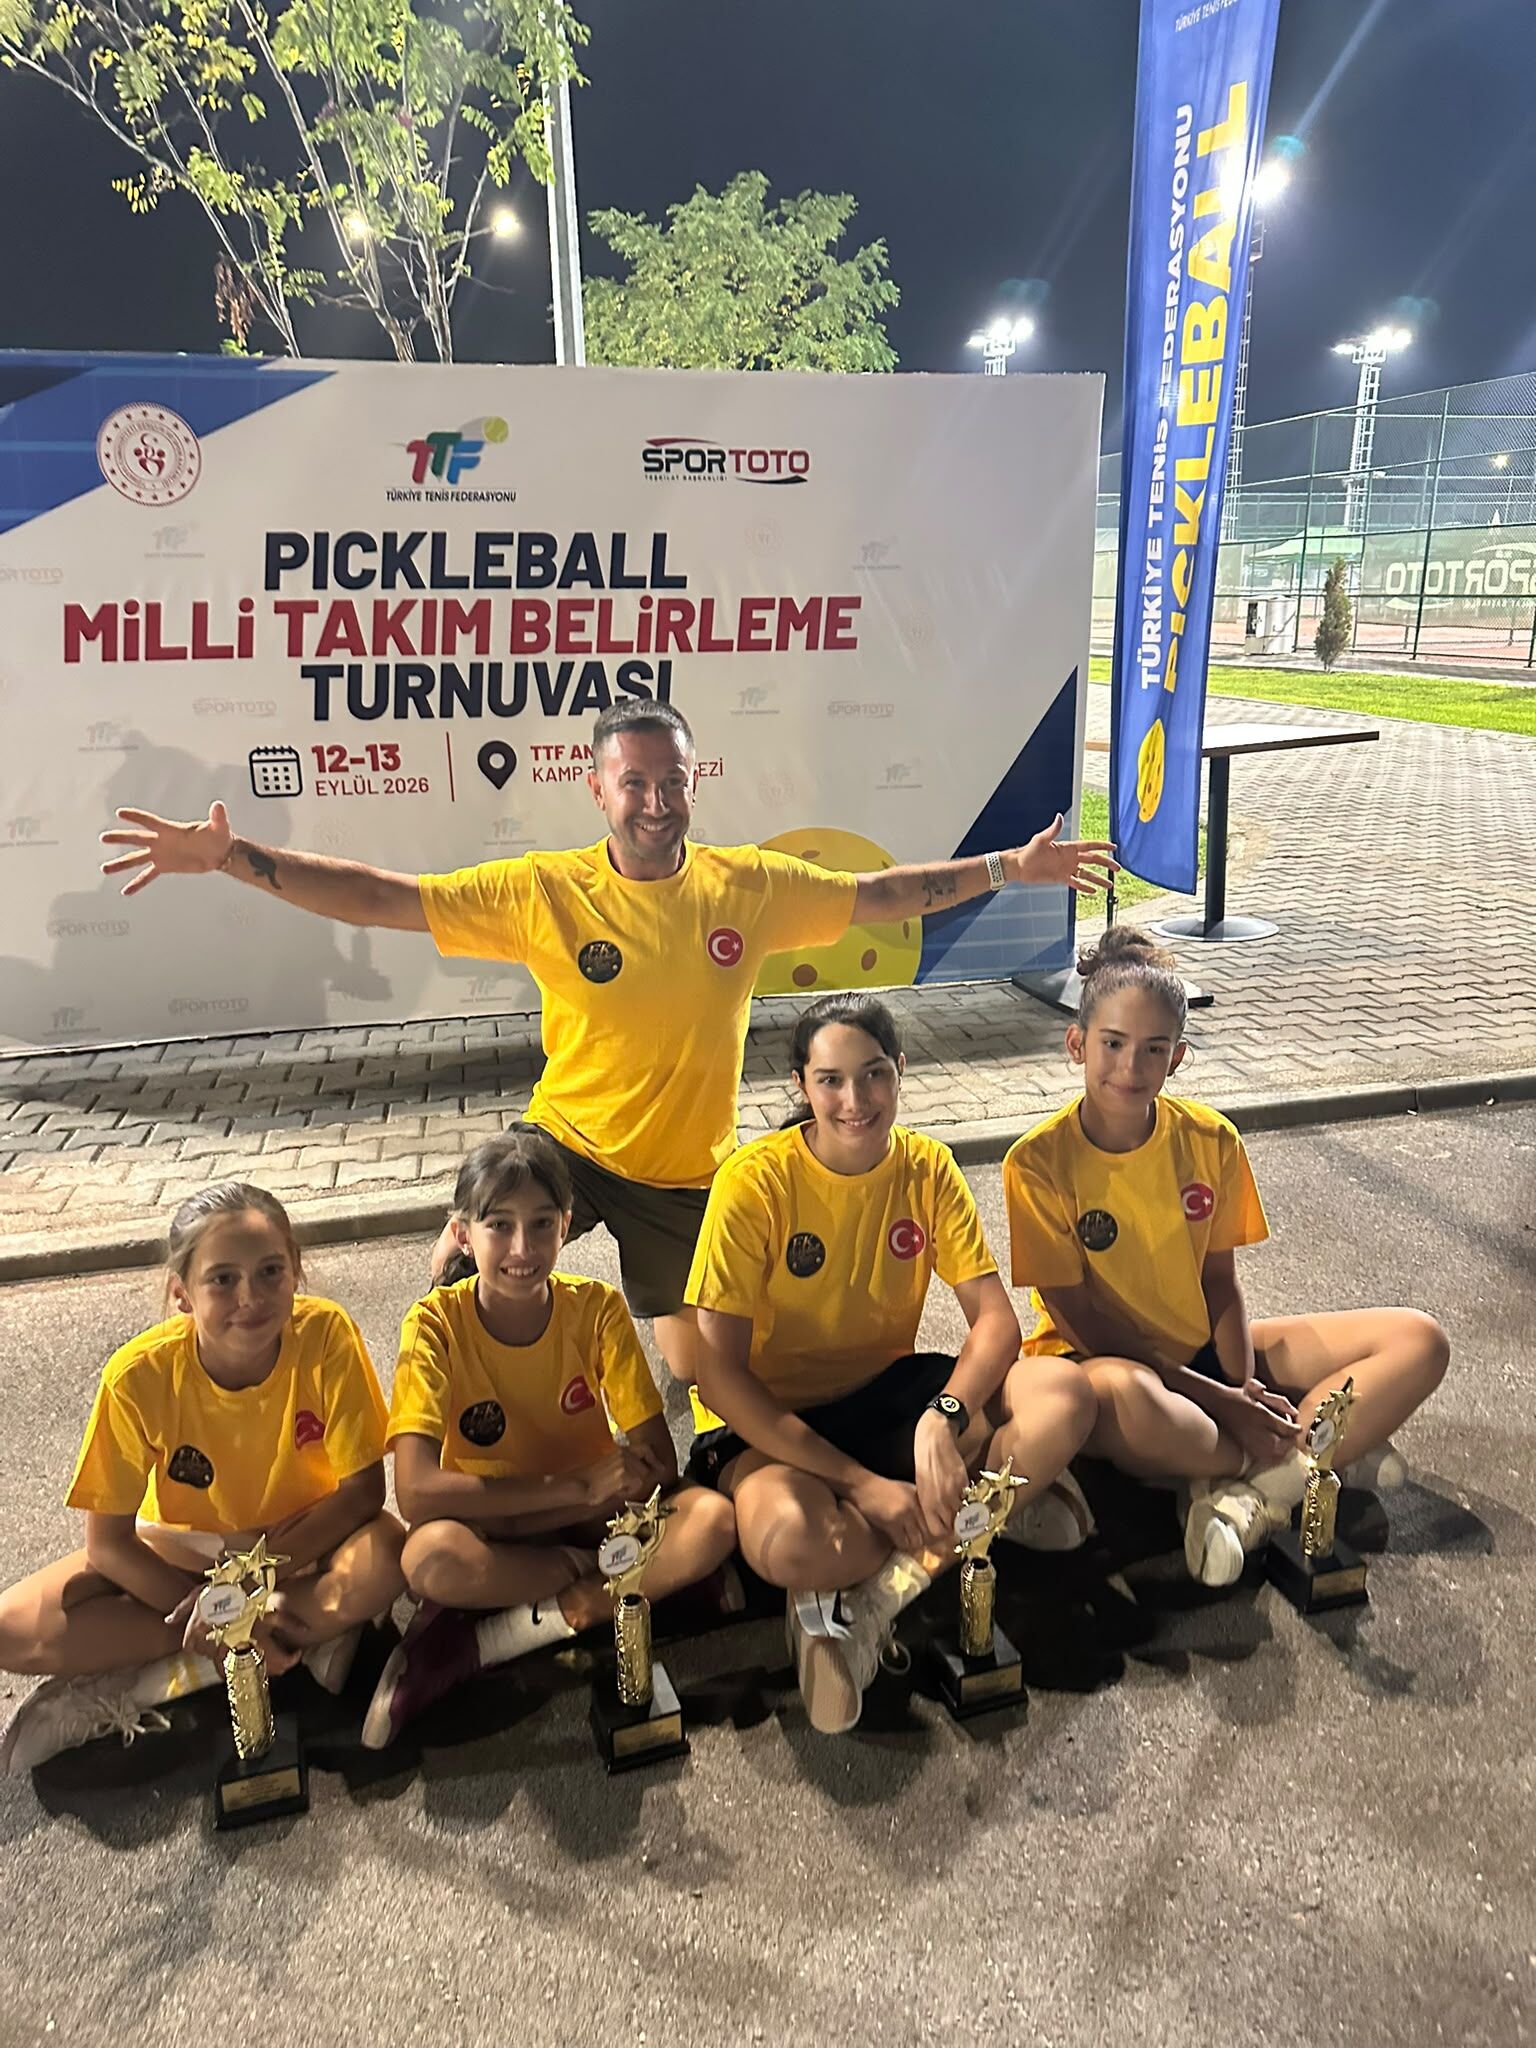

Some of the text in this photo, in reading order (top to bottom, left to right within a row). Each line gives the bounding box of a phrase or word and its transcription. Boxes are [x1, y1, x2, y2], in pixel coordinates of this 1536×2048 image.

[1137, 103, 1193, 690] TÜRKİYE TENİS FEDERASYONU
[406, 431, 486, 485] TTF
[386, 488, 518, 502] TÜRKİYE TENİS FEDERASYONU
[264, 531, 688, 591] PICKLEBALL
[274, 598, 492, 658] TAKIM
[300, 659, 673, 722] TURNUVASI
[311, 743, 402, 774] 12-13
[530, 744, 566, 761] TTF
[315, 775, 430, 796] EYLÜL 2026
[532, 765, 583, 783] KAMP
